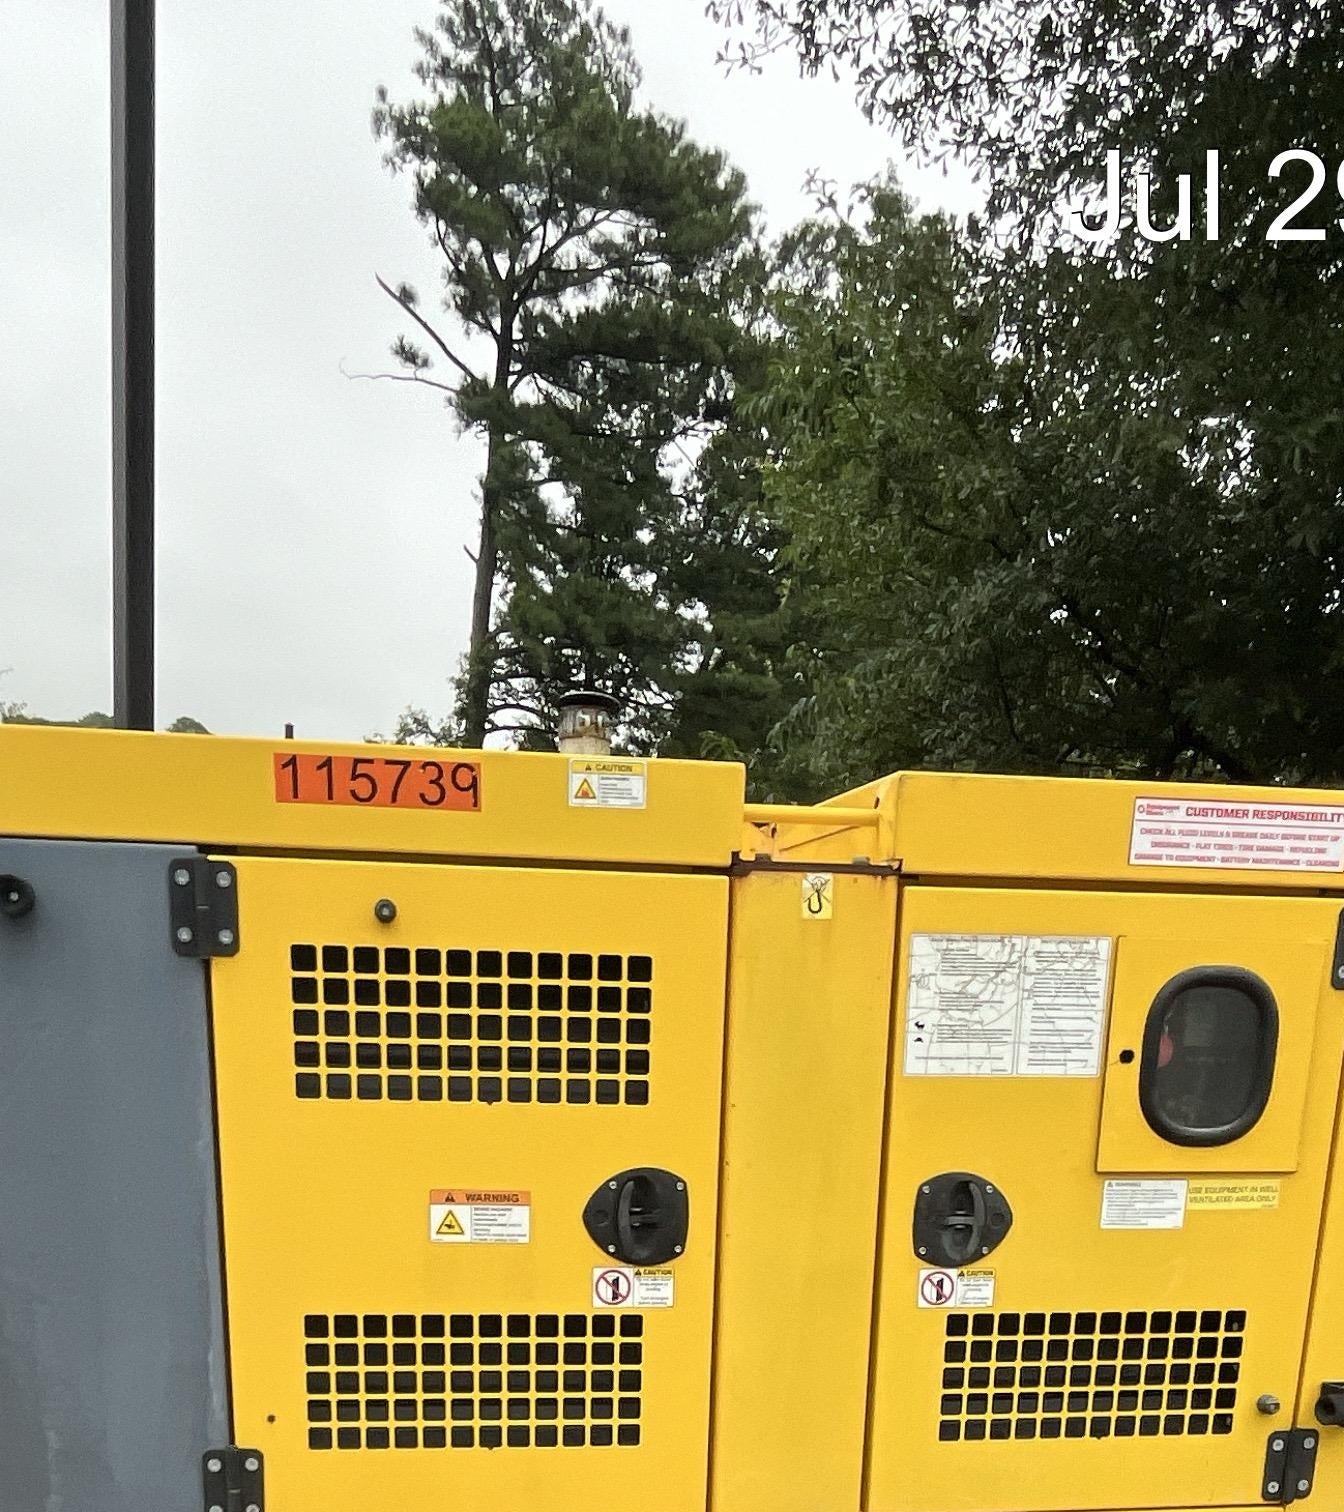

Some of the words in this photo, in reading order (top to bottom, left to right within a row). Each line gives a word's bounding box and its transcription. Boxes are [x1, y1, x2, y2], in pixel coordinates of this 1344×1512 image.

[595, 763, 633, 772] CAUTION
[281, 754, 479, 809] 115739
[1185, 806, 1250, 819] CUSTOMER
[465, 1193, 520, 1203] WARNING
